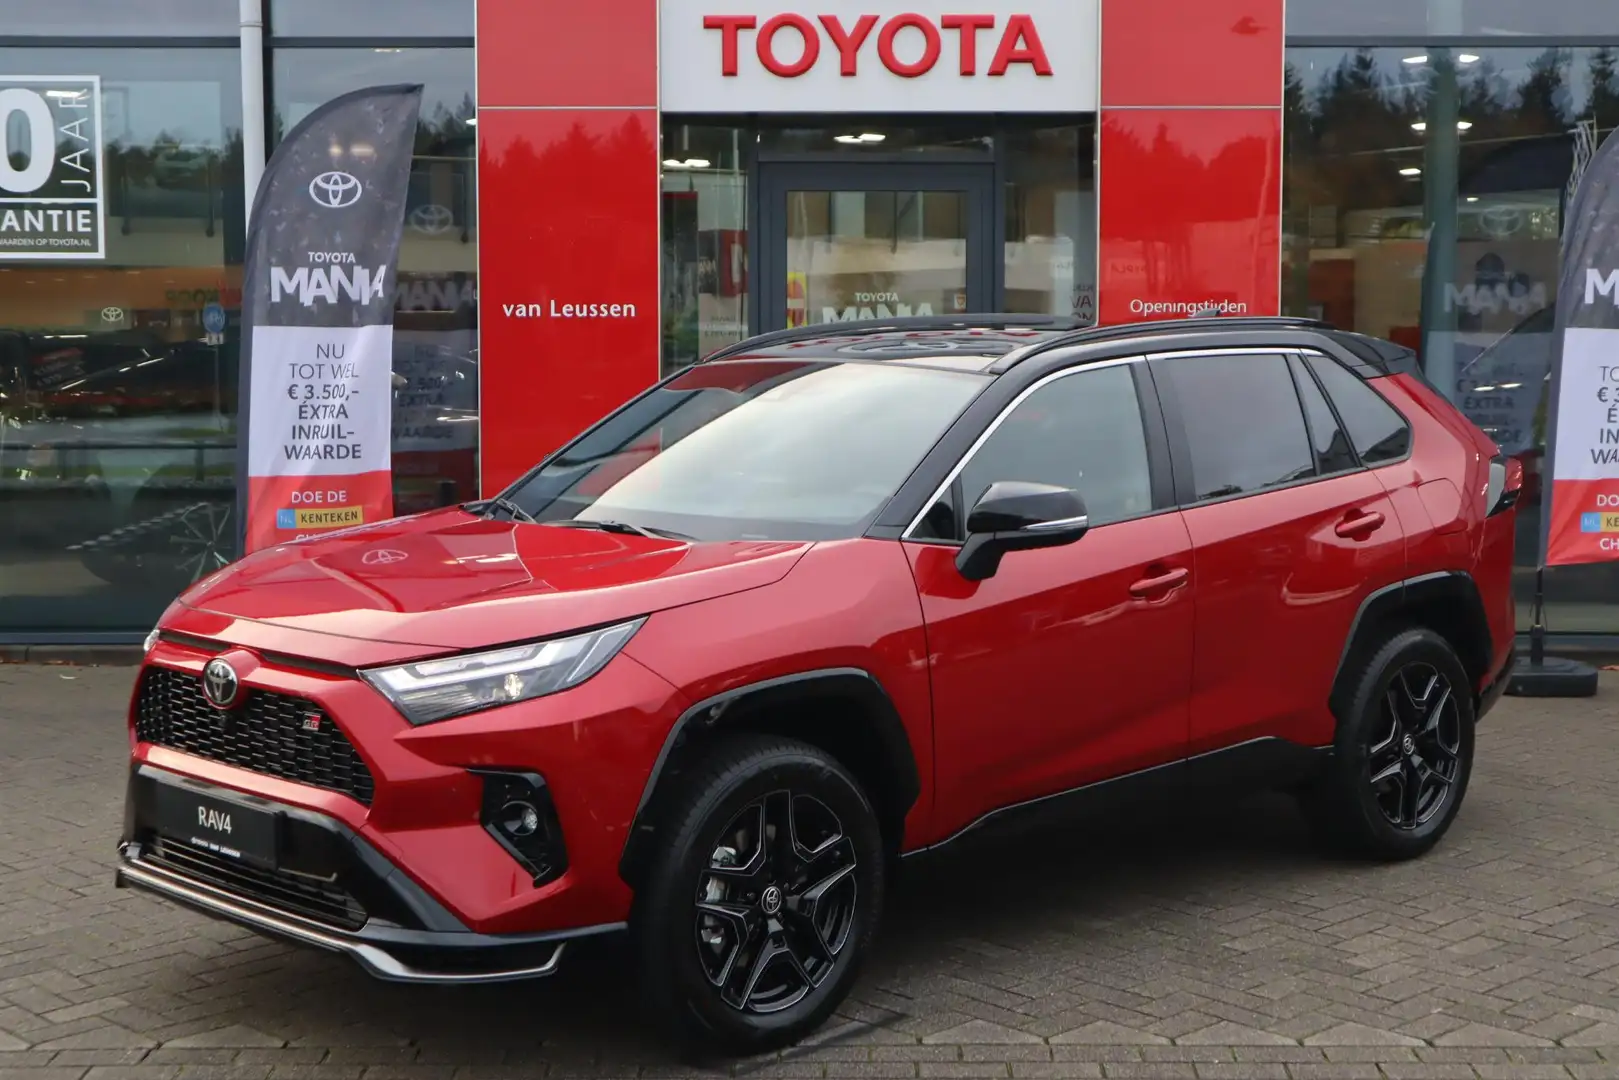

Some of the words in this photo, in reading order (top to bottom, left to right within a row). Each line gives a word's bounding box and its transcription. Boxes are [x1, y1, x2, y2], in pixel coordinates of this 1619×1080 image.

[703, 12, 1053, 78] TOYOTA
[59, 88, 91, 192] JAAR
[308, 251, 356, 264] TOYOTA
[855, 292, 899, 302] TOYOTA
[502, 303, 541, 317] van
[550, 299, 636, 317] Leussen
[316, 343, 345, 359] NU
[289, 363, 325, 379] TOT
[331, 363, 359, 379] WEL
[287, 384, 299, 400] €
[304, 384, 360, 401] 3.500,-
[1597, 387, 1608, 402] €
[291, 424, 354, 440] INRUIL-
[284, 444, 361, 460] WAARDE
[291, 491, 323, 503] DOE
[327, 491, 347, 502] DE
[300, 510, 358, 523] KENTEKEN
[198, 806, 232, 834] RAV4
